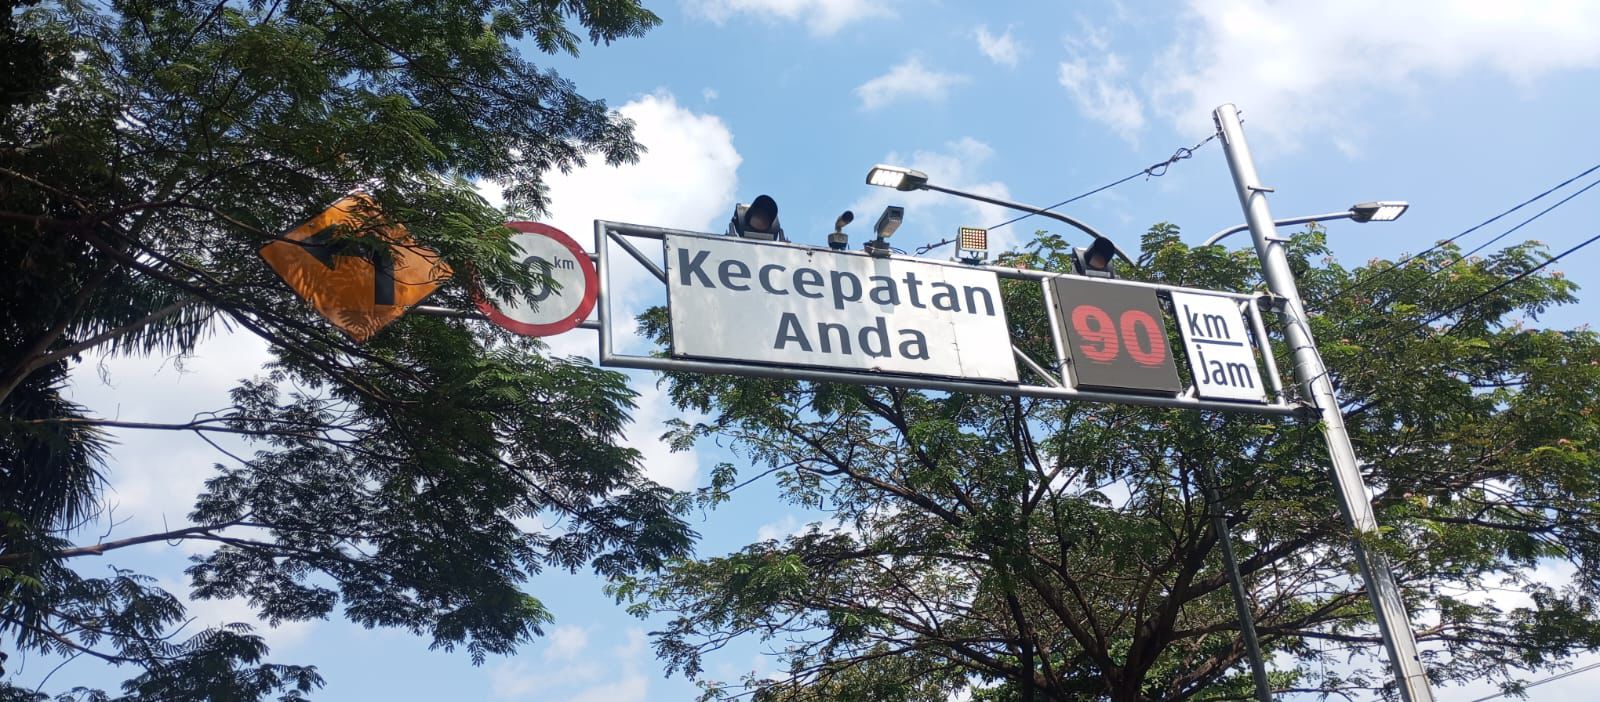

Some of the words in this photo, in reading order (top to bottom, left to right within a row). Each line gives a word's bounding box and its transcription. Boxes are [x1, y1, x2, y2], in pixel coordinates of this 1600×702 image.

[553, 255, 575, 270] km
[677, 247, 996, 317] Kecepatan
[773, 311, 931, 361] Anda
[1071, 304, 1166, 368] 90
[1183, 304, 1231, 340] km
[1196, 344, 1255, 389] jam
